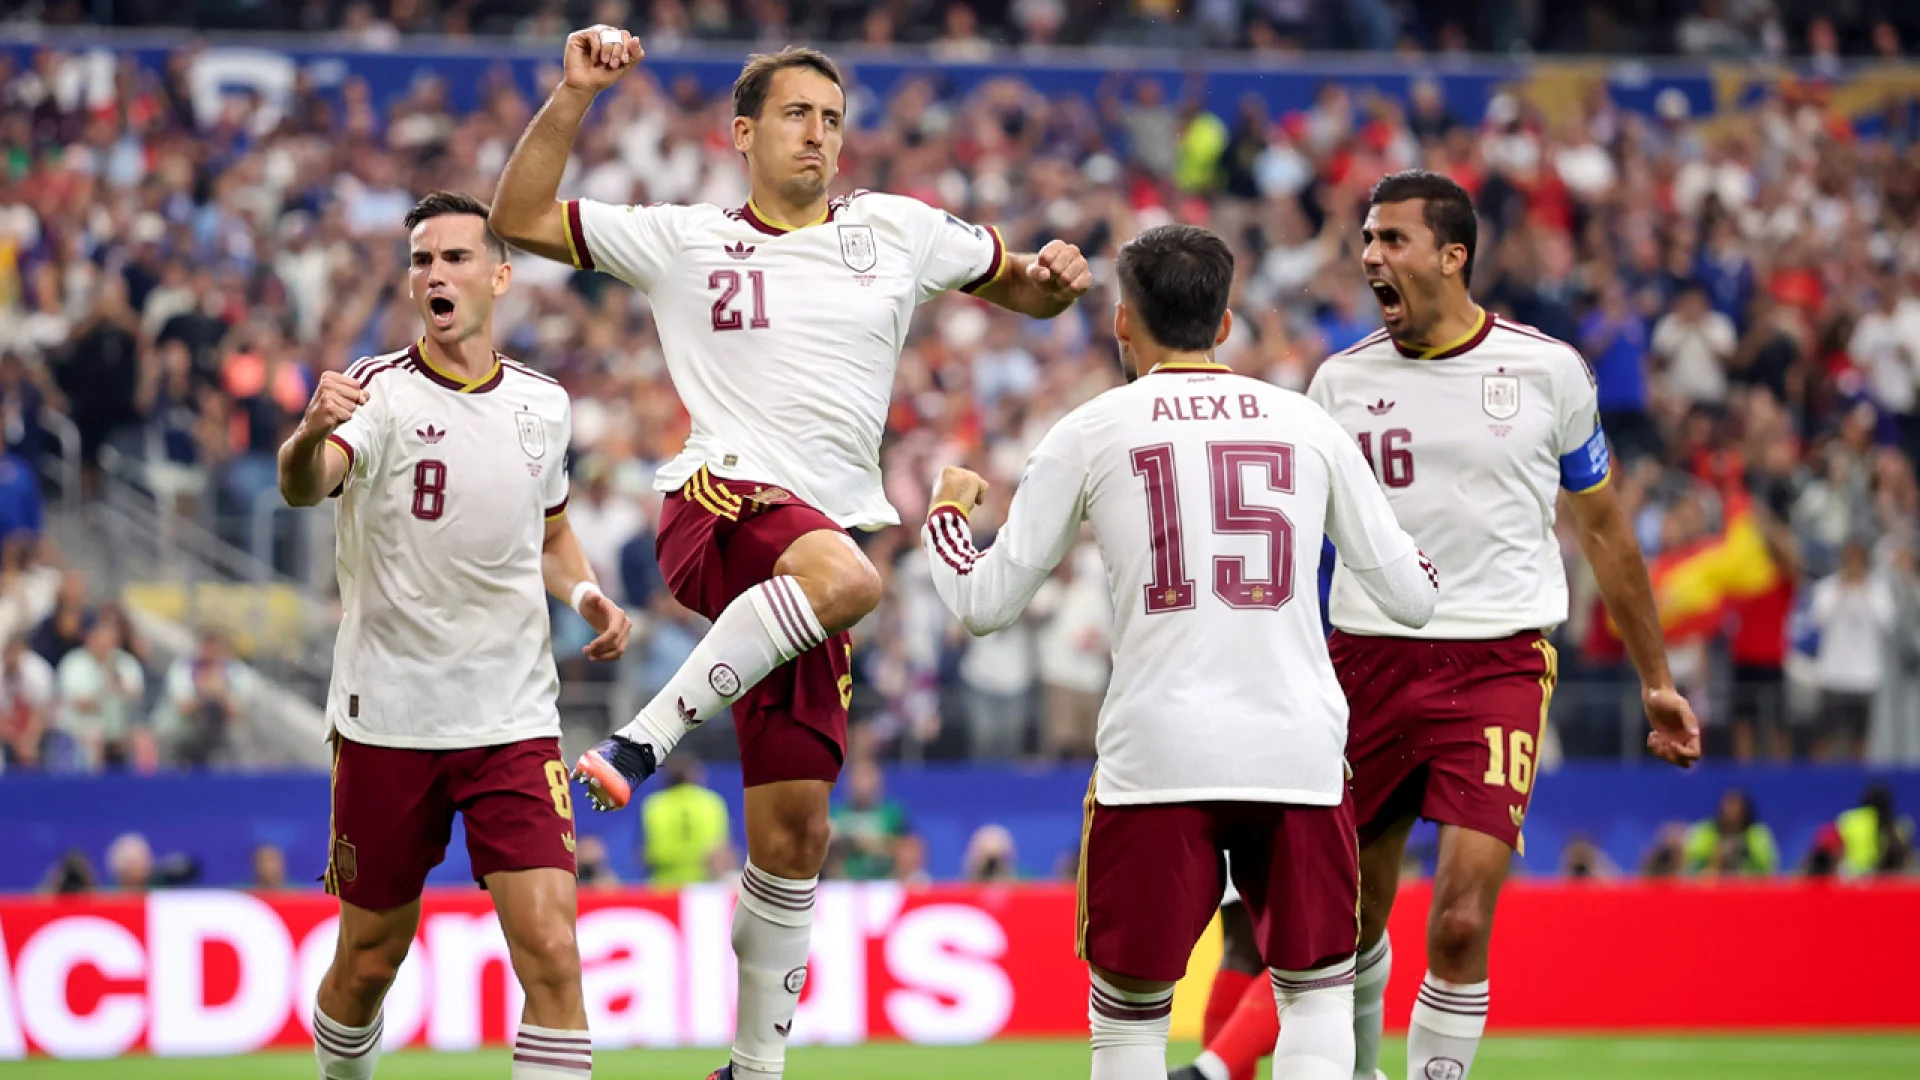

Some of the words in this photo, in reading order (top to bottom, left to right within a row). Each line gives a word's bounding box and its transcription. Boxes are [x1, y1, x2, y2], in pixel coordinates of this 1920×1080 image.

[708, 270, 770, 331] 21
[1152, 395, 1231, 422] ALEX
[1239, 393, 1268, 420] B.
[1357, 428, 1414, 489] 16
[411, 459, 447, 522] 8
[1130, 441, 1295, 614] 15
[544, 759, 572, 820] 8
[1483, 726, 1534, 795] 16
[0, 880, 1015, 1060] cDnald's
